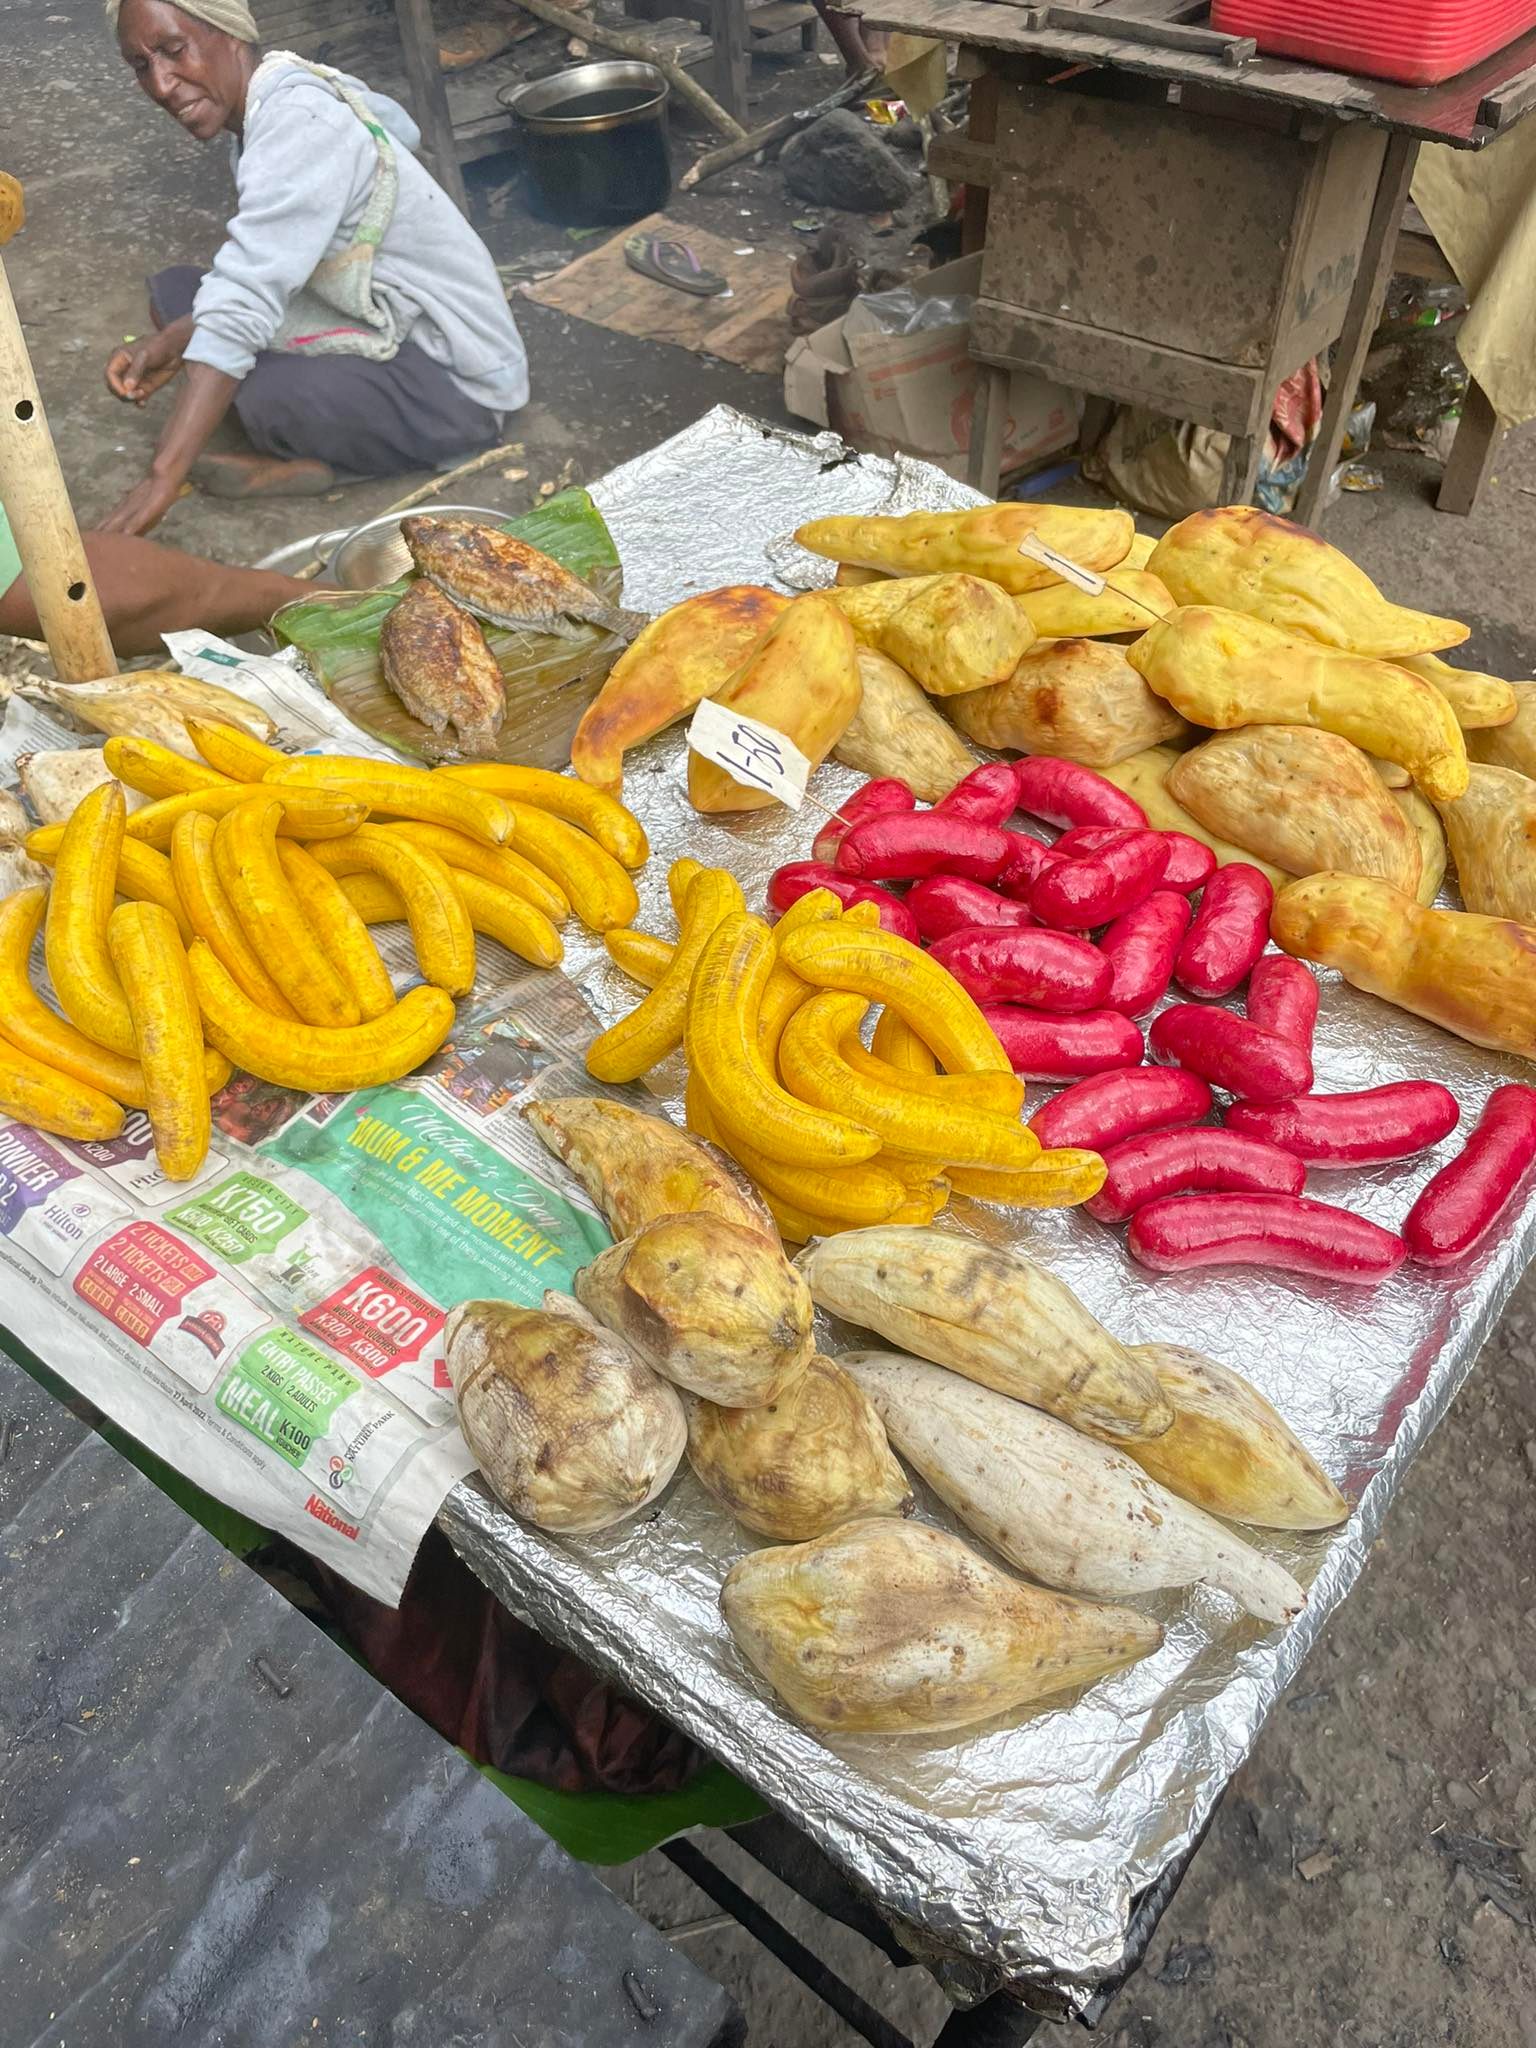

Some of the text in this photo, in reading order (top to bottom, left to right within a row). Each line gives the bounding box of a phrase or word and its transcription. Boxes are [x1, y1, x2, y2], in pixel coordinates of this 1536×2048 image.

[209, 1183, 287, 1235] K750
[346, 1115, 413, 1164] MUM
[397, 1146, 431, 1172] &
[414, 1159, 467, 1200] ME
[450, 1185, 565, 1268] MOMENT
[44, 1203, 84, 1240] Hilton
[208, 1227, 245, 1254] K250
[108, 1237, 128, 1251] 2
[119, 1243, 168, 1284] TICKETS
[128, 1223, 148, 1237] 2
[140, 1229, 189, 1270] TICKETS
[82, 1278, 113, 1308] COMBO
[93, 1255, 105, 1268] 2
[100, 1260, 130, 1288] LARGE
[117, 1306, 148, 1336] COMBO
[128, 1282, 140, 1297] 2
[135, 1287, 165, 1318] SMALL
[342, 1280, 428, 1347] K600
[315, 1313, 353, 1339] K300
[350, 1337, 390, 1368] K300
[332, 1305, 356, 1327] WORTH
[354, 1320, 367, 1333] OF
[364, 1326, 401, 1357] VOUCHERS
[257, 1340, 300, 1373] ENTRY
[290, 1365, 338, 1406] PASSES
[261, 1364, 285, 1387] 2 KIDS
[280, 1330, 324, 1363] NATURE
[322, 1363, 355, 1387] PARK
[220, 1375, 280, 1441] MEAL
[285, 1384, 319, 1414] 2 ADULTS
[205, 1416, 222, 1434] Terms
[225, 1431, 255, 1459] Conditions
[275, 1435, 302, 1460] VOUCHER
[279, 1417, 311, 1451] K100
[348, 1410, 397, 1463] NATURE PARK
[303, 1493, 361, 1541] National
